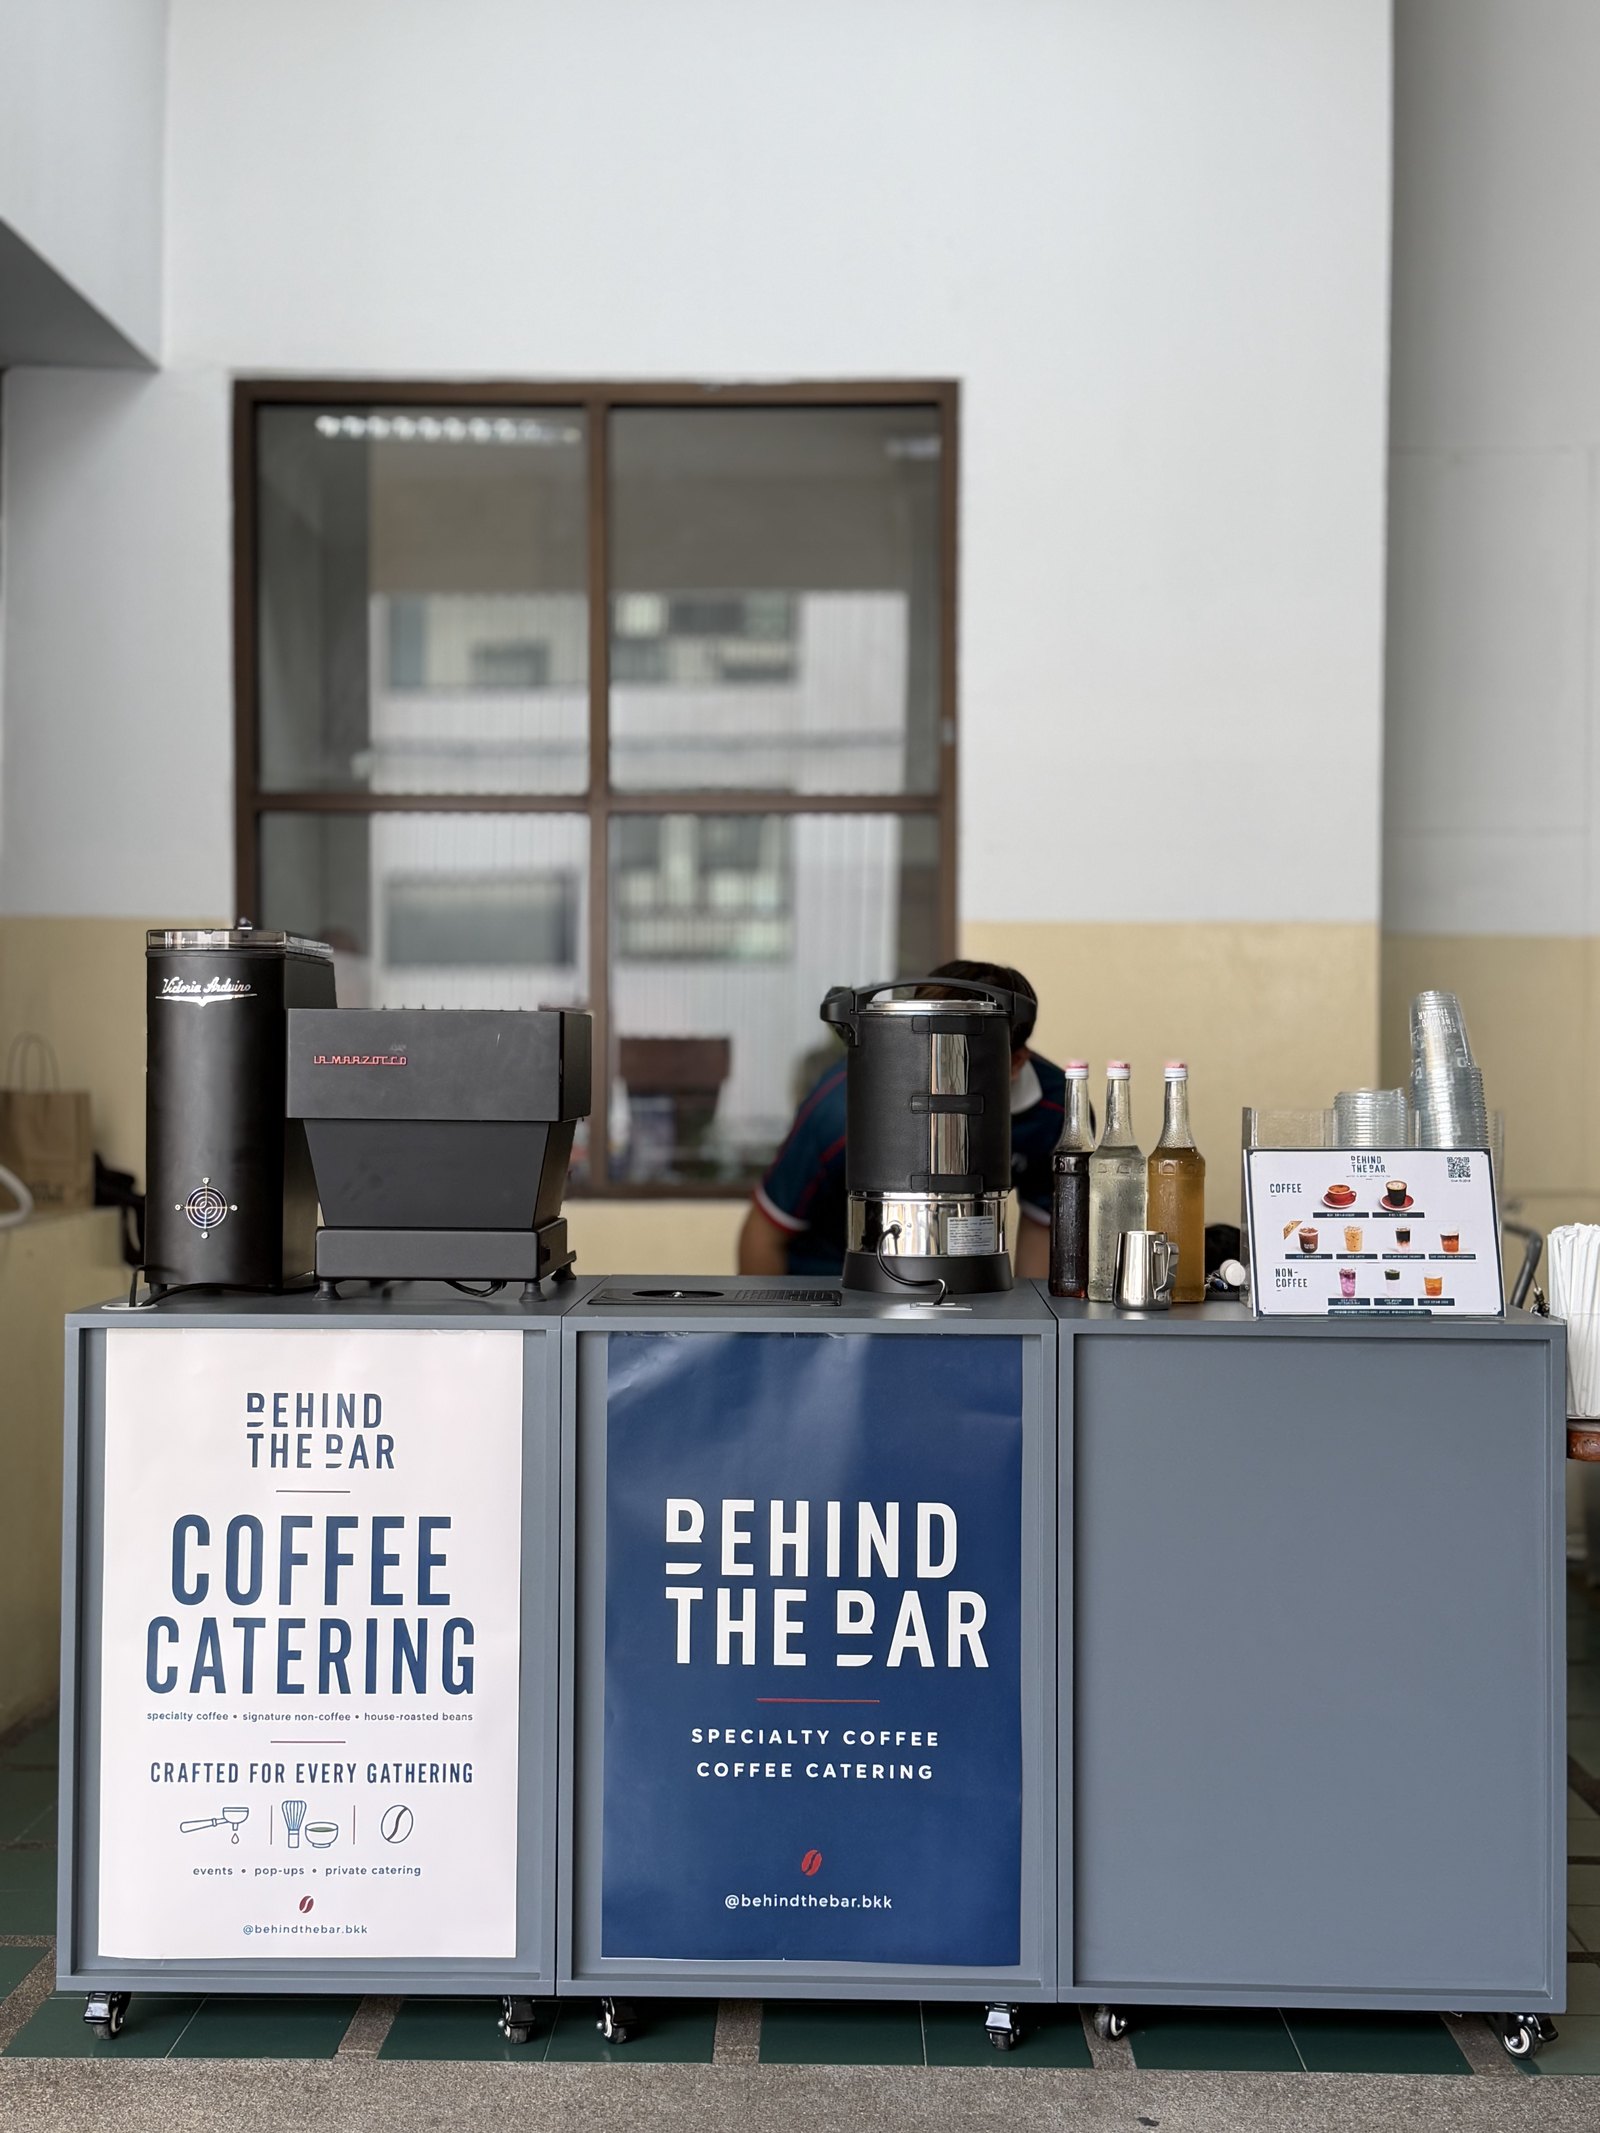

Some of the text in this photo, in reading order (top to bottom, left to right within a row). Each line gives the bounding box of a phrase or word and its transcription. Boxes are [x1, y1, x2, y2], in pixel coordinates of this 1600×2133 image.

[162, 976, 252, 994] Victoria Arduino
[313, 1055, 326, 1064] LA
[1350, 1155, 1382, 1165] BEHIND
[1351, 1164, 1386, 1173] THE BAR
[1269, 1183, 1302, 1194] COFFEE
[1275, 1268, 1298, 1278] NON-
[1275, 1278, 1308, 1288] COFFEE
[246, 1392, 382, 1428] BEHIND
[246, 1434, 395, 1470] THE BAR
[665, 1498, 958, 1579] BEHIND
[171, 1514, 452, 1606] COFFEE
[665, 1586, 989, 1668] THE BAR
[146, 1615, 475, 1696] CATERING
[146, 1711, 473, 1723] specialty coffee signature non-coffee house-roasted beans
[691, 1728, 939, 1747] SPECIALTY COFFEE
[150, 1762, 473, 1784] CRAFTED FOR EVERY GATHERING
[696, 1762, 933, 1780] COFFEE CATERING
[192, 1865, 421, 1878] events pop-ups private catering
[724, 1893, 893, 1910] @behindthebar.bkk
[242, 1924, 368, 1935] @behindthebar.bkk
